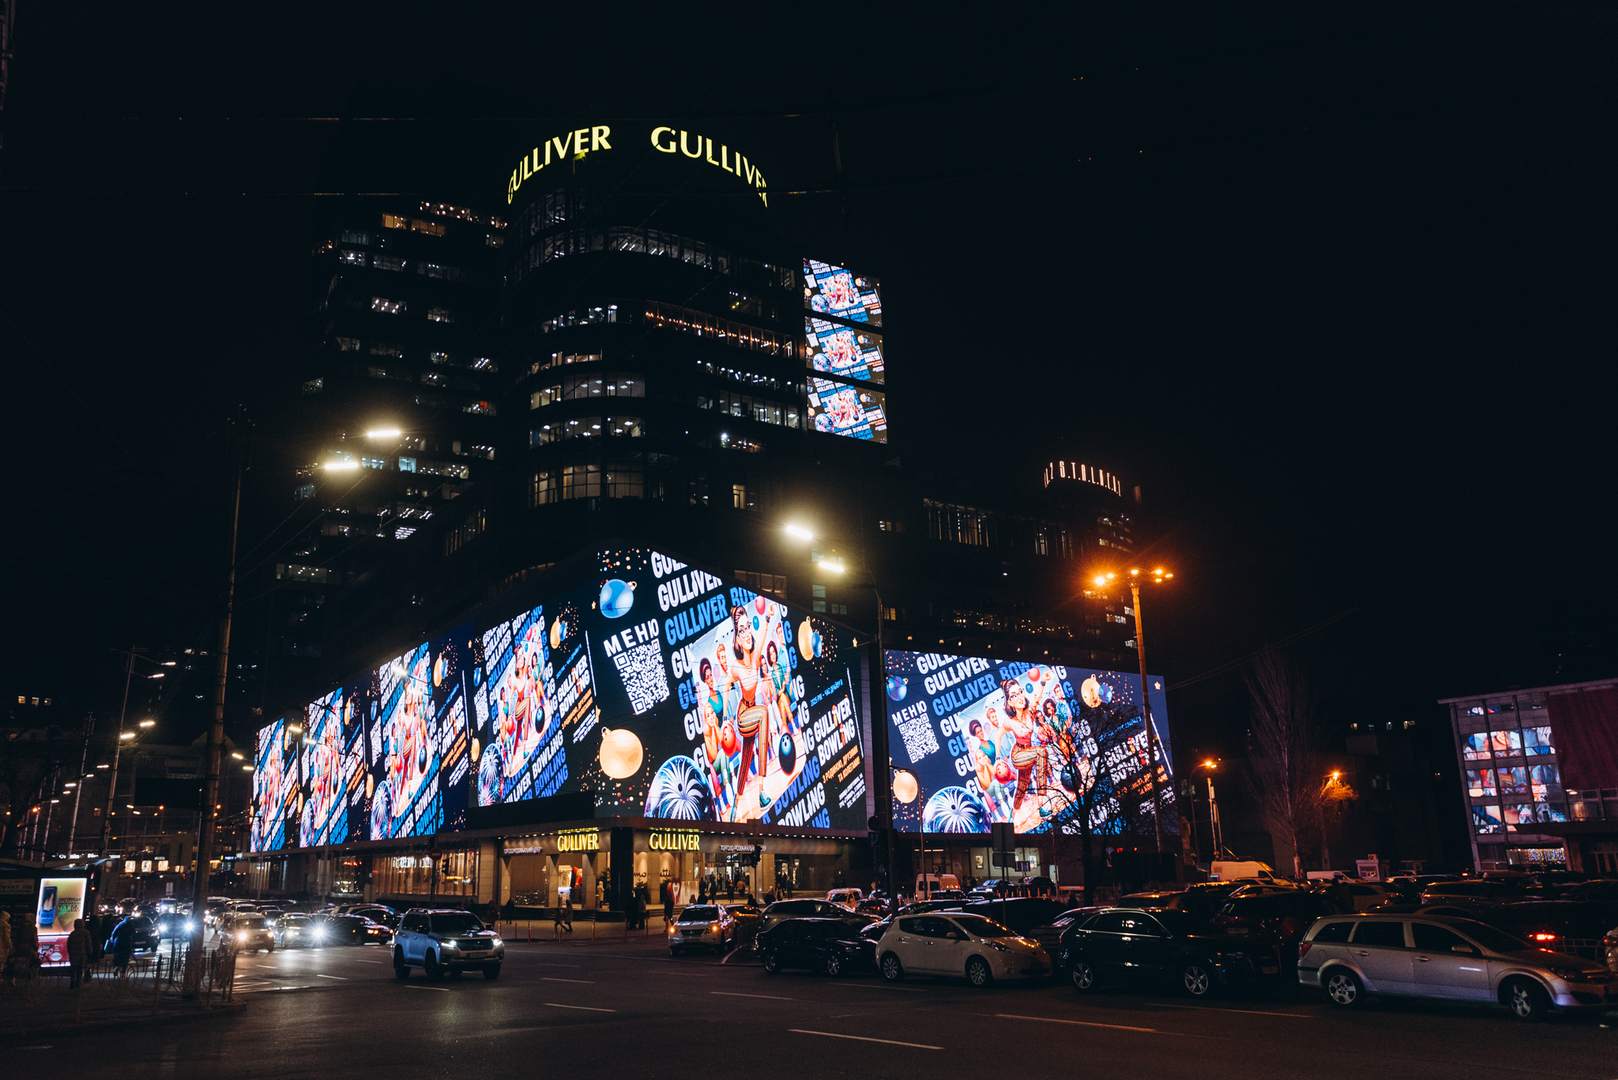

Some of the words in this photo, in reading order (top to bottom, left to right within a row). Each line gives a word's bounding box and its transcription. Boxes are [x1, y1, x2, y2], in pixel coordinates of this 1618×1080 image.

[508, 125, 612, 205] GULLIVER
[665, 594, 729, 645] GULLIVER
[558, 655, 588, 702] GULLIVER
[559, 670, 590, 718] BOWLING
[932, 674, 998, 716] GULLIVER
[814, 697, 852, 742] GULLIVER
[892, 700, 927, 726] МЕНЮ
[532, 730, 564, 780] BOWLING
[817, 718, 856, 766] BOWLING
[534, 747, 566, 796] BOWLING
[557, 833, 600, 852] GULLIVER
[648, 832, 700, 851] GULLIVER
